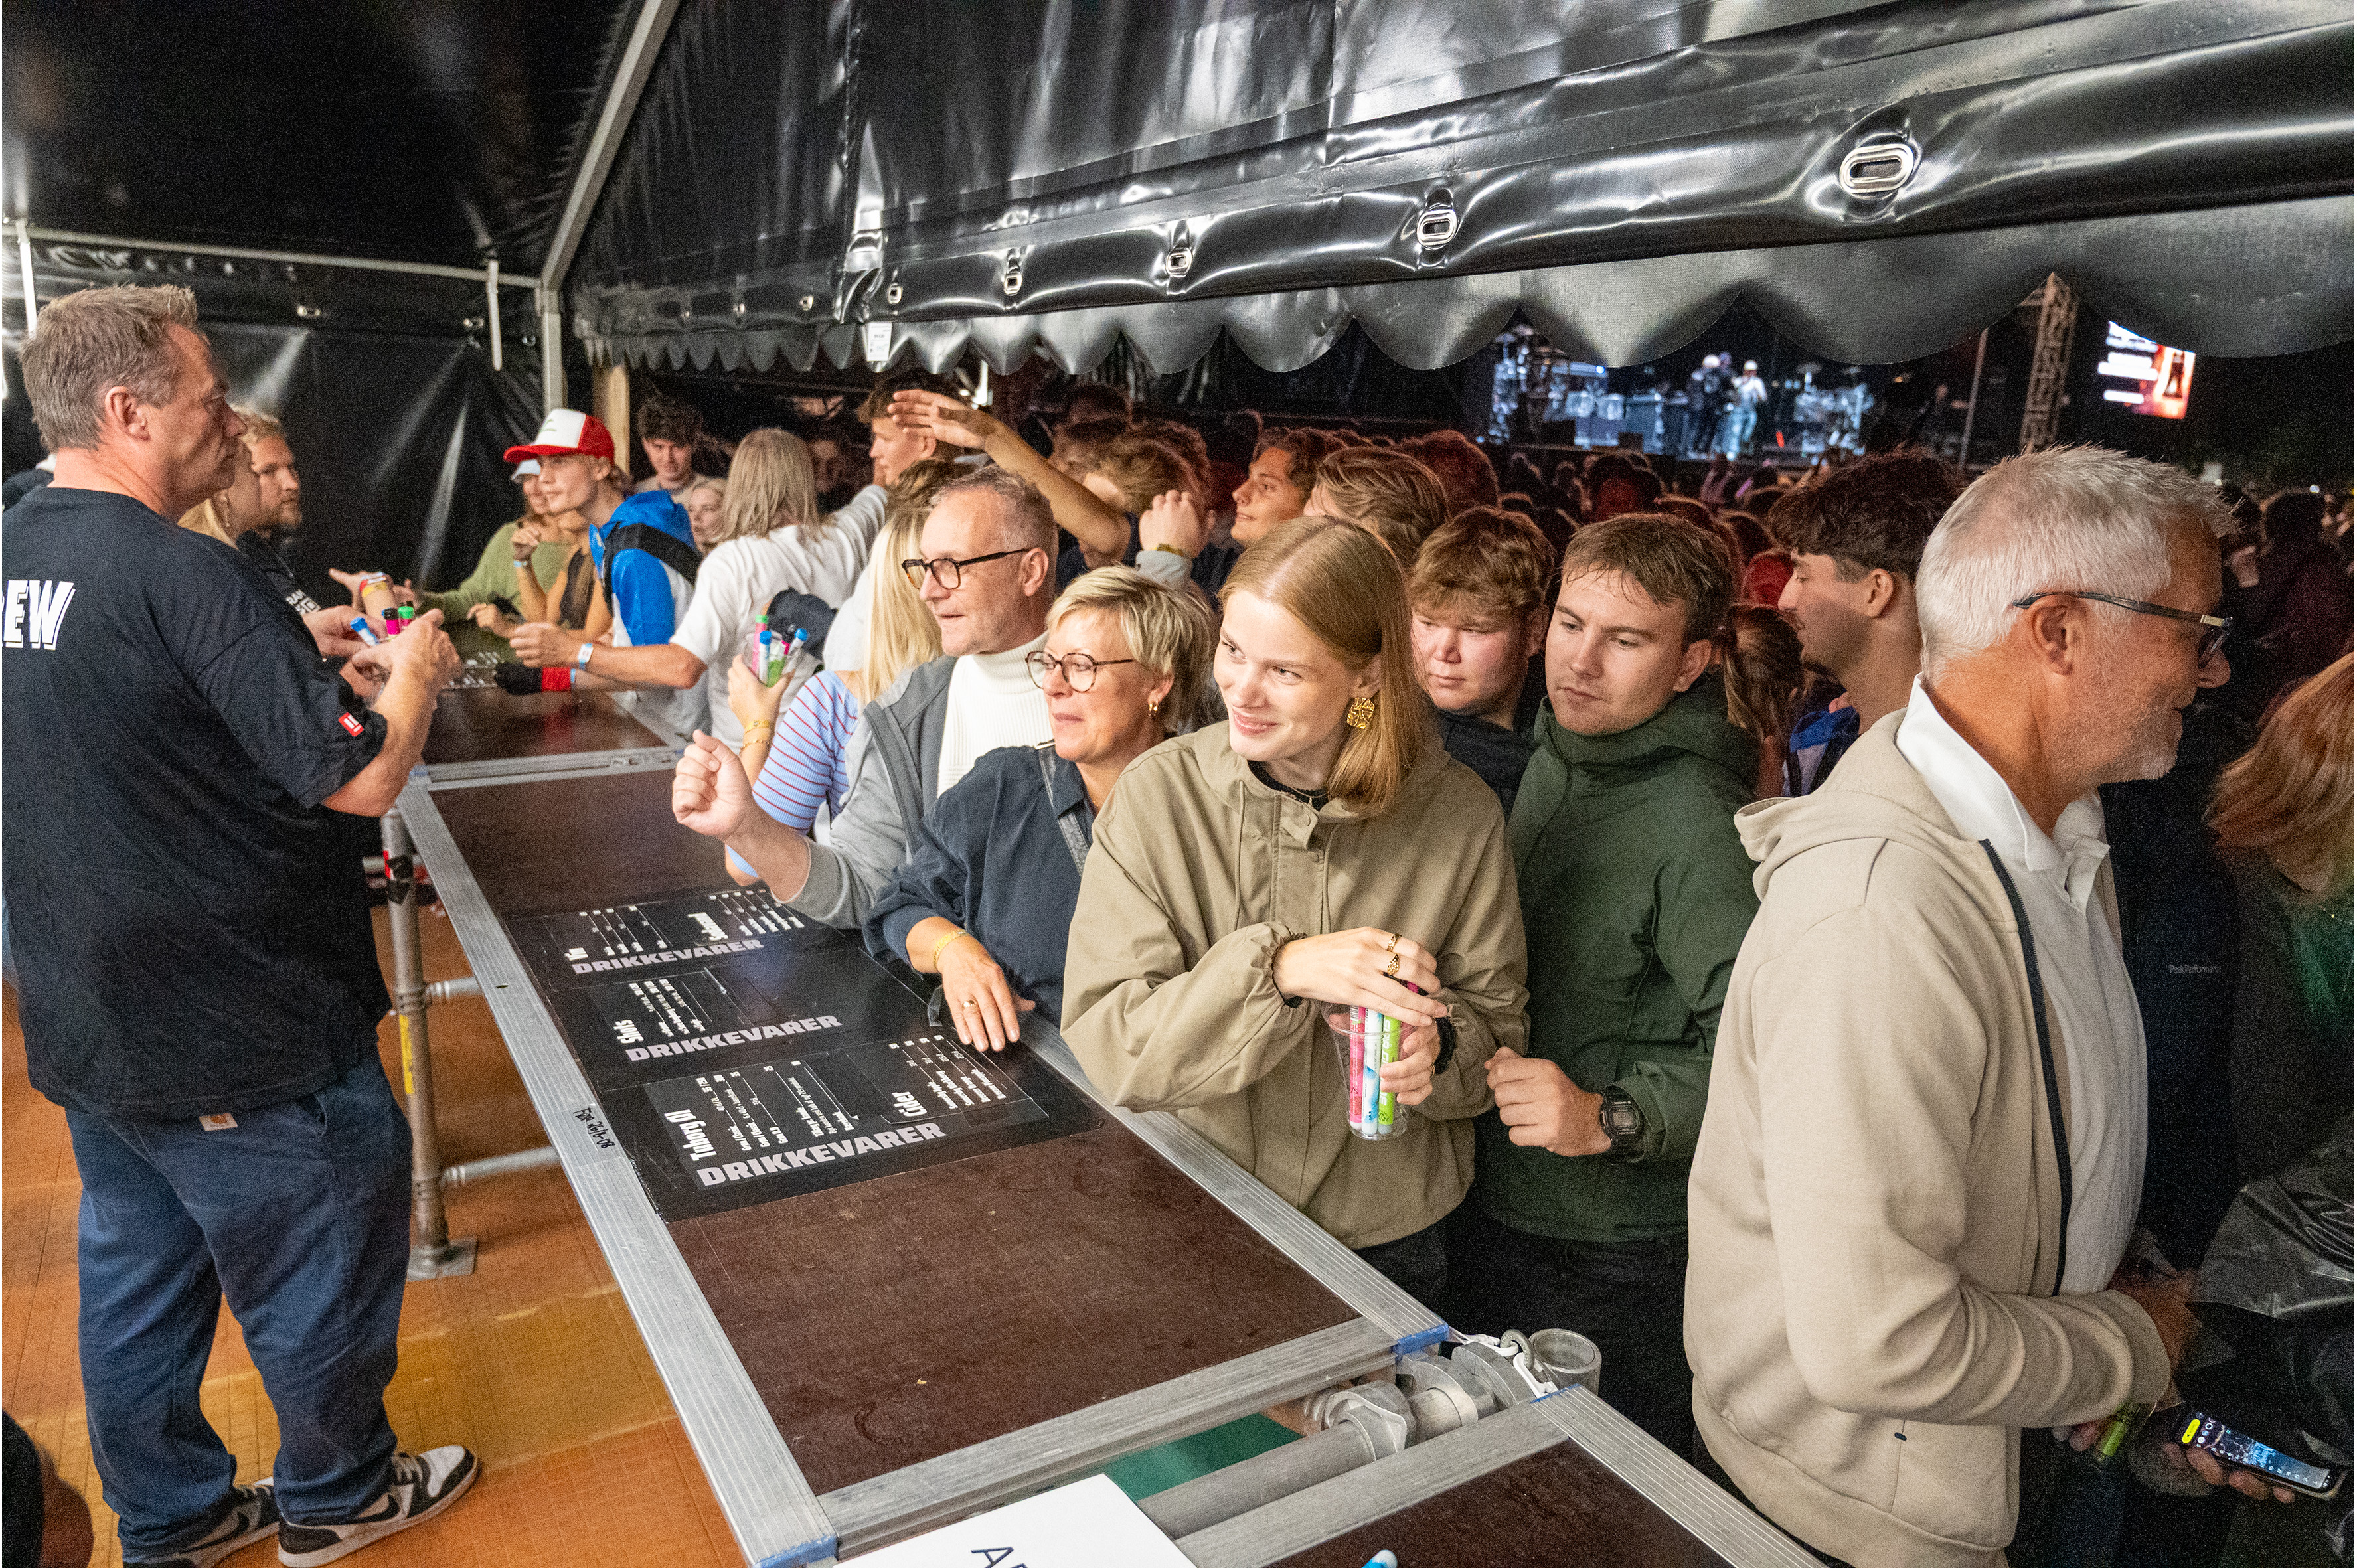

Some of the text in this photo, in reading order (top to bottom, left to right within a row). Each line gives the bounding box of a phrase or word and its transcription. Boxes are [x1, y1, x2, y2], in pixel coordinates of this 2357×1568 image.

[2, 579, 76, 651] EW
[564, 947, 588, 961] Vin
[572, 939, 764, 974] DRIKKEVARER
[613, 1019, 644, 1044] Shots
[625, 1015, 843, 1061] DRIKKEVARER
[892, 1091, 928, 1117] Cider
[664, 1109, 717, 1162] Tuborg Øl
[696, 1122, 947, 1186] DRIKKEVARER
[971, 1547, 1028, 1568] A
